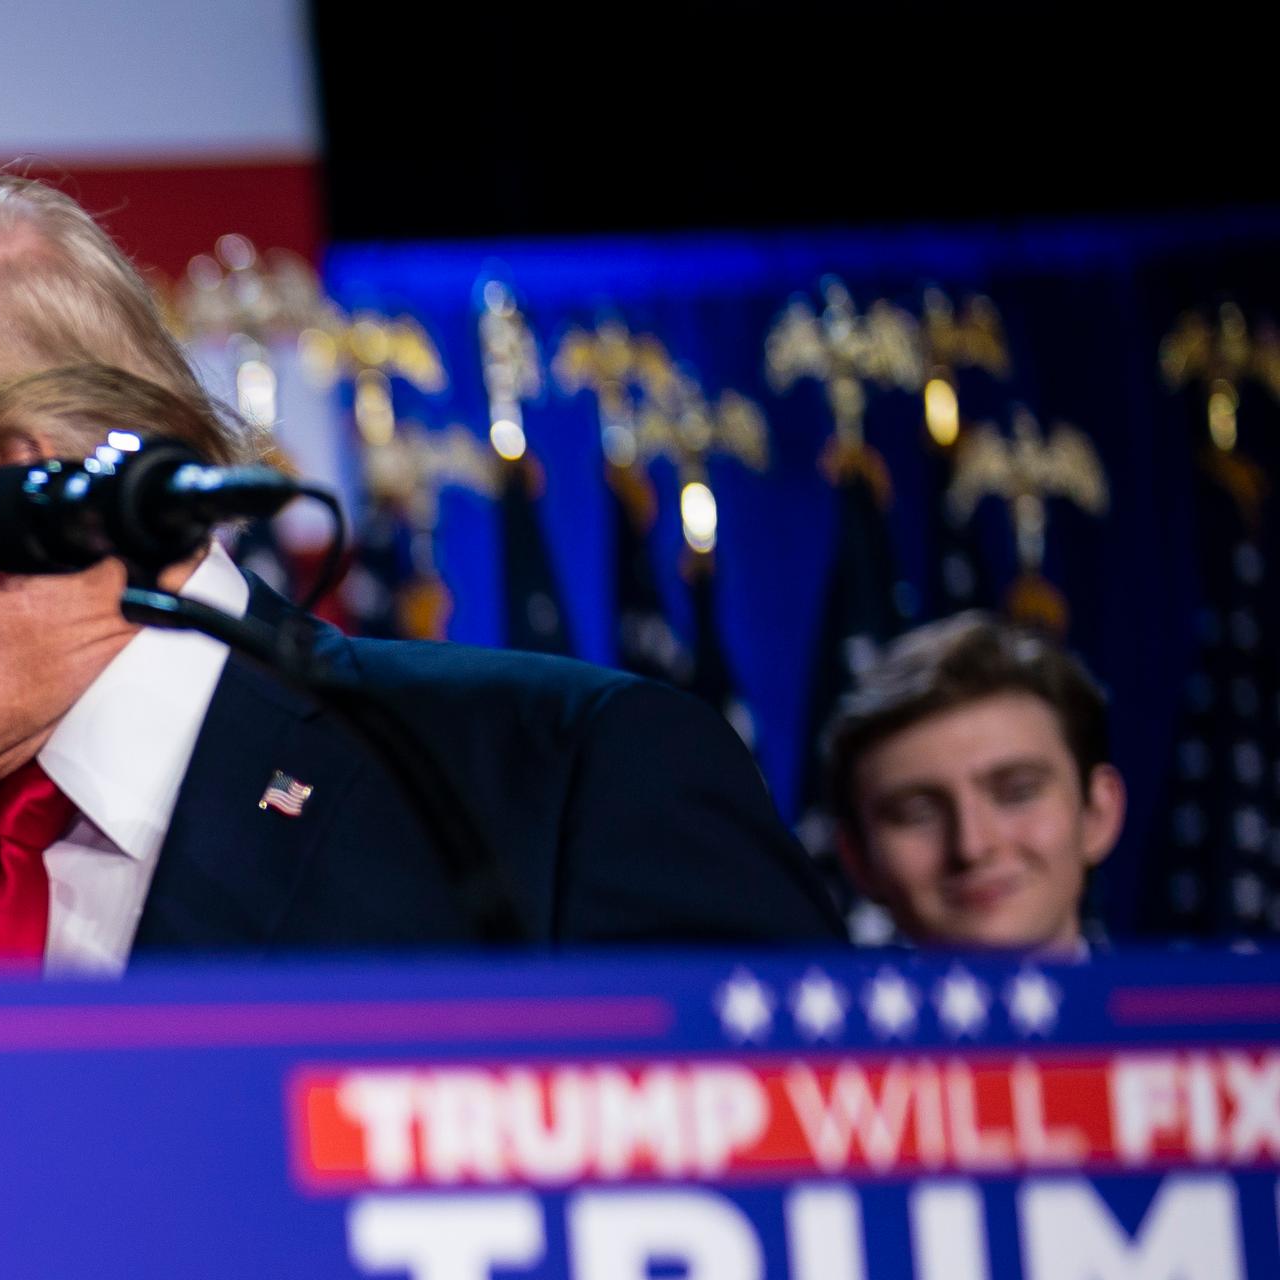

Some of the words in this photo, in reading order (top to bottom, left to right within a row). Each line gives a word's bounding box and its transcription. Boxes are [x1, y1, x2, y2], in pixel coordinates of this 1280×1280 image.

[340, 1064, 771, 1184] TRUMP
[782, 1058, 1088, 1174] WILL
[1110, 1052, 1280, 1167] FIX
